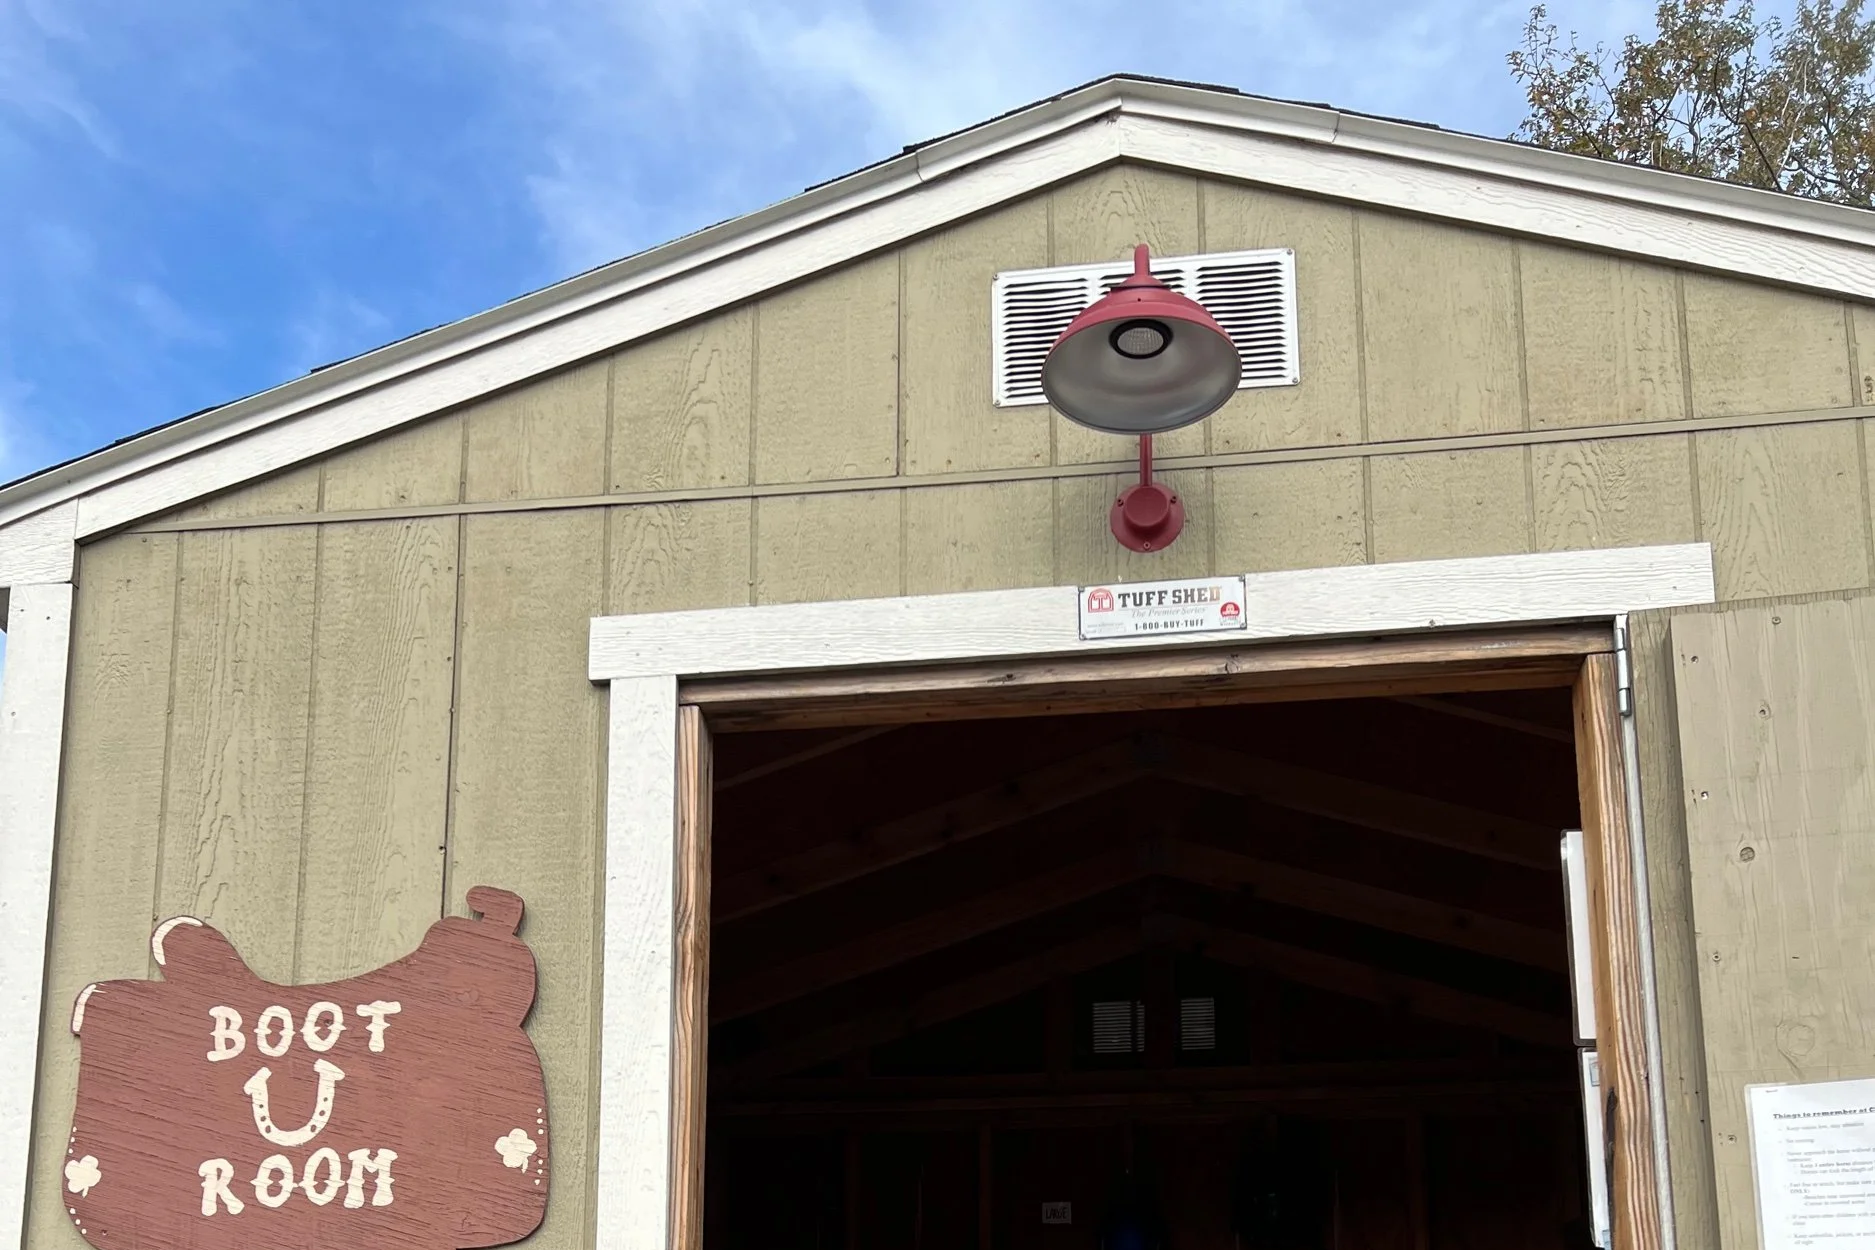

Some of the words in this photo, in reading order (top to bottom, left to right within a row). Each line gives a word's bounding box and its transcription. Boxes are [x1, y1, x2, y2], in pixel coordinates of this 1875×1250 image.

[1118, 590, 1168, 608] TUFF
[1172, 587, 1221, 605] SHED
[206, 1000, 402, 1062] BOOT
[199, 1147, 399, 1216] ROOM
